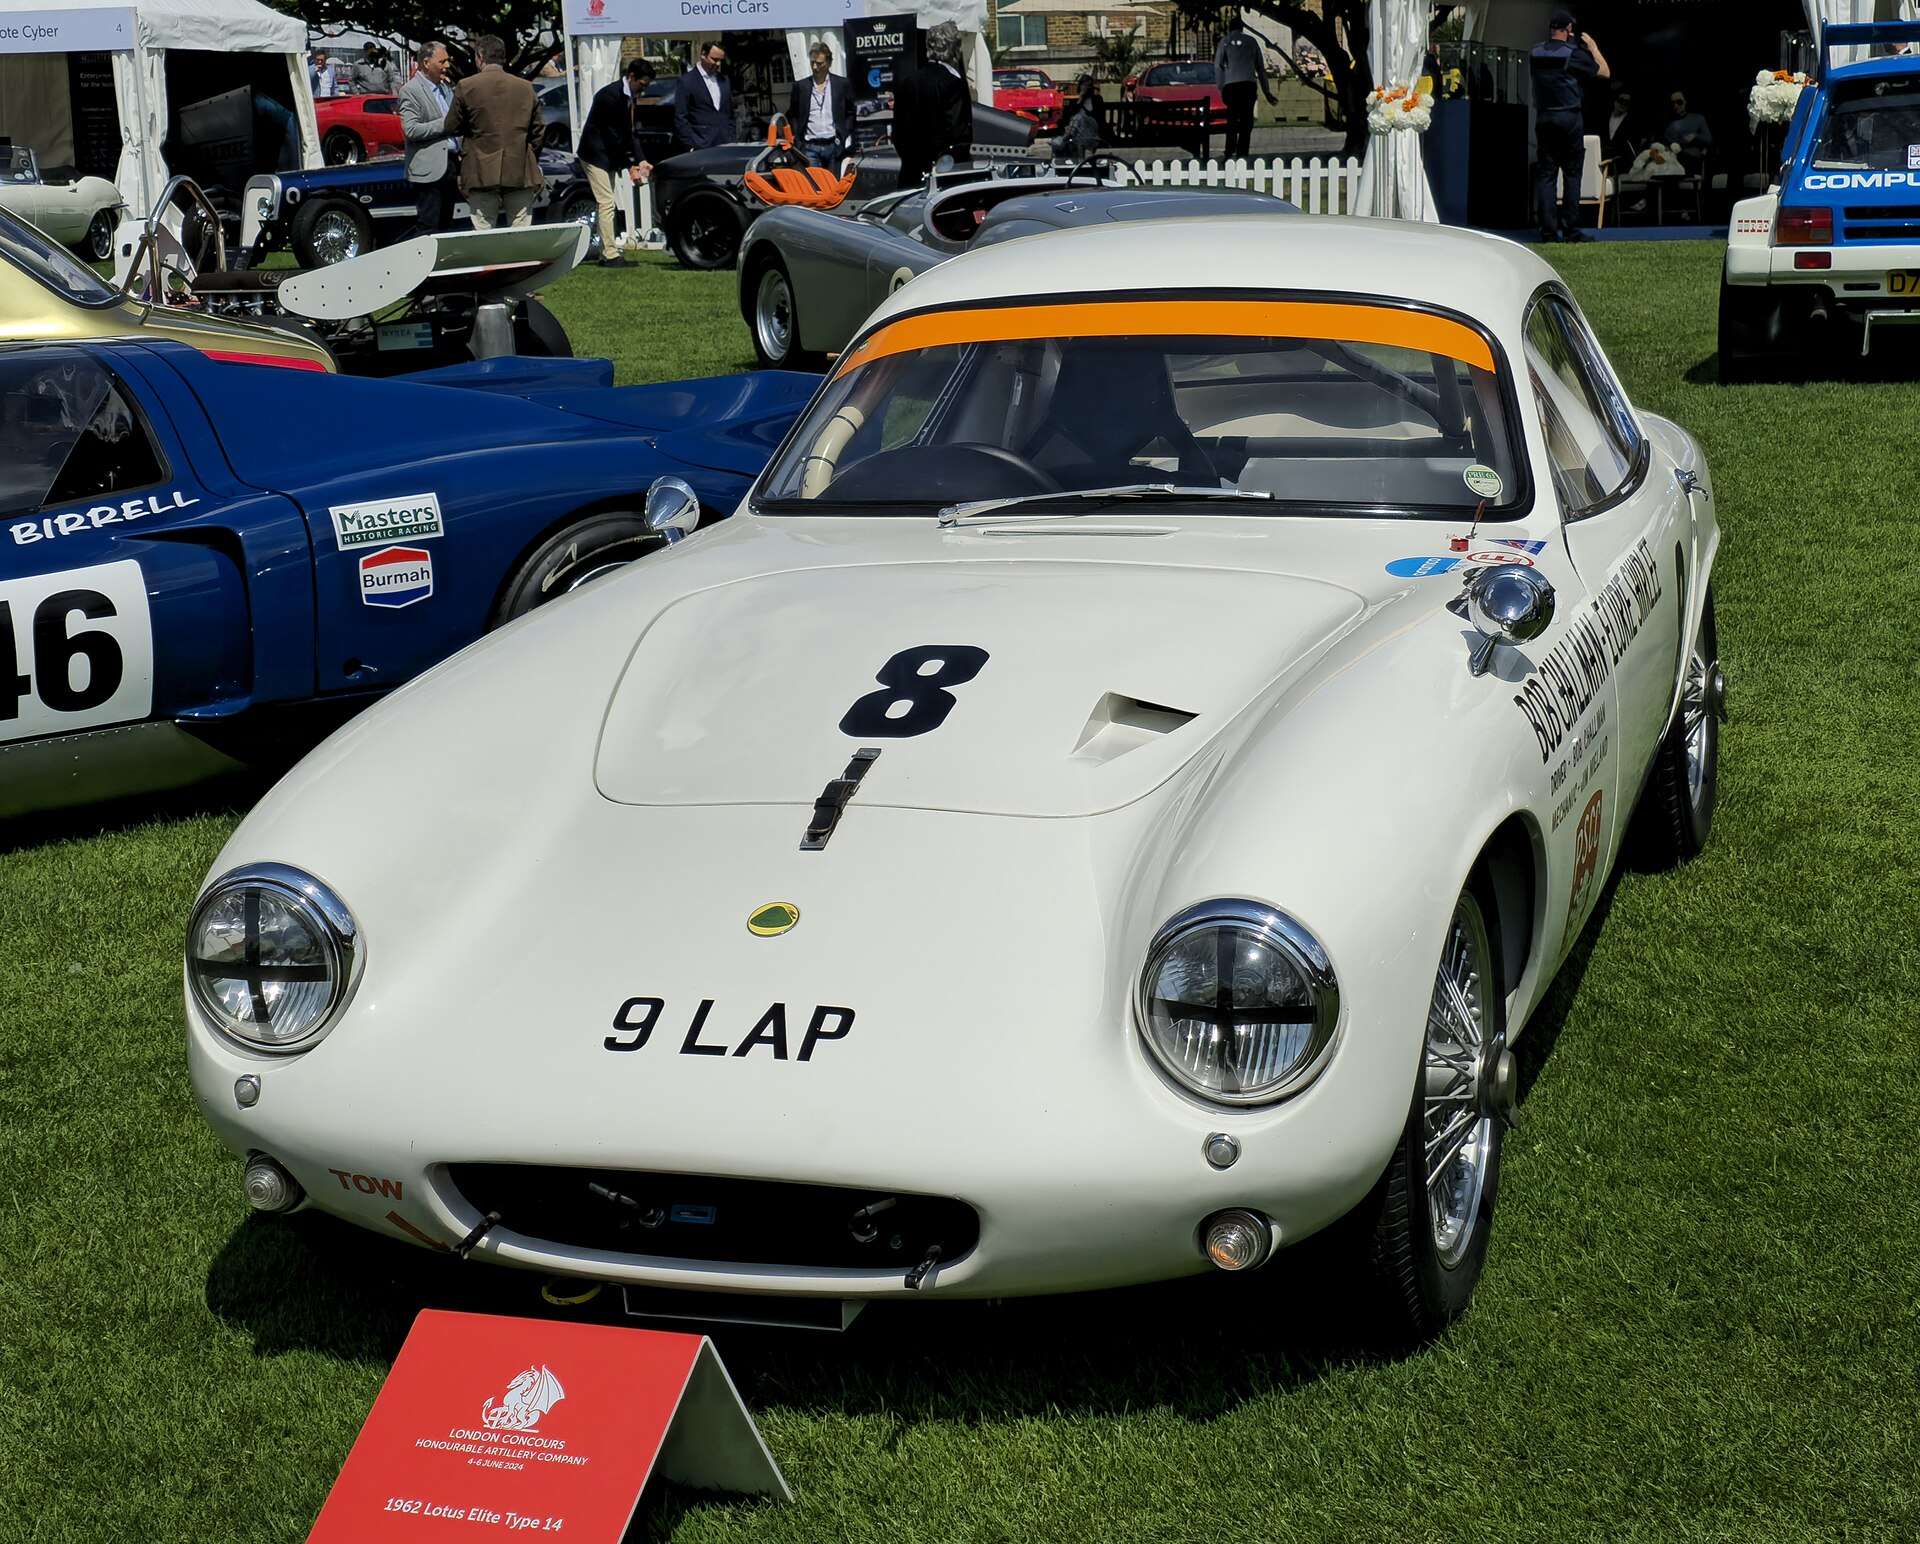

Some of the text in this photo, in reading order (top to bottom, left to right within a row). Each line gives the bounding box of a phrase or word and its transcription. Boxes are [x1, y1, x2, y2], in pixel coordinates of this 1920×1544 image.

[681, 0, 769, 15] Devinci Cars
[22, 25, 59, 40] Cyber
[116, 23, 122, 33] 4
[855, 33, 904, 48] DEVINCI
[9, 491, 202, 545] BIRRELL
[338, 506, 435, 532] Masters
[343, 523, 437, 544] HISTORIC RACING
[362, 567, 430, 588] Burmah
[838, 644, 990, 738] 8
[603, 996, 857, 1062] 9 LAP
[328, 1168, 403, 1200] TOW
[449, 1428, 566, 1450] LONDON CONCOURS
[415, 1438, 589, 1466] HONOURABLE ARTILLERY COMPANY
[467, 1457, 524, 1471] 4-6 JUNE 2024
[383, 1498, 563, 1532] 1962 Lotus Elite Type 14
